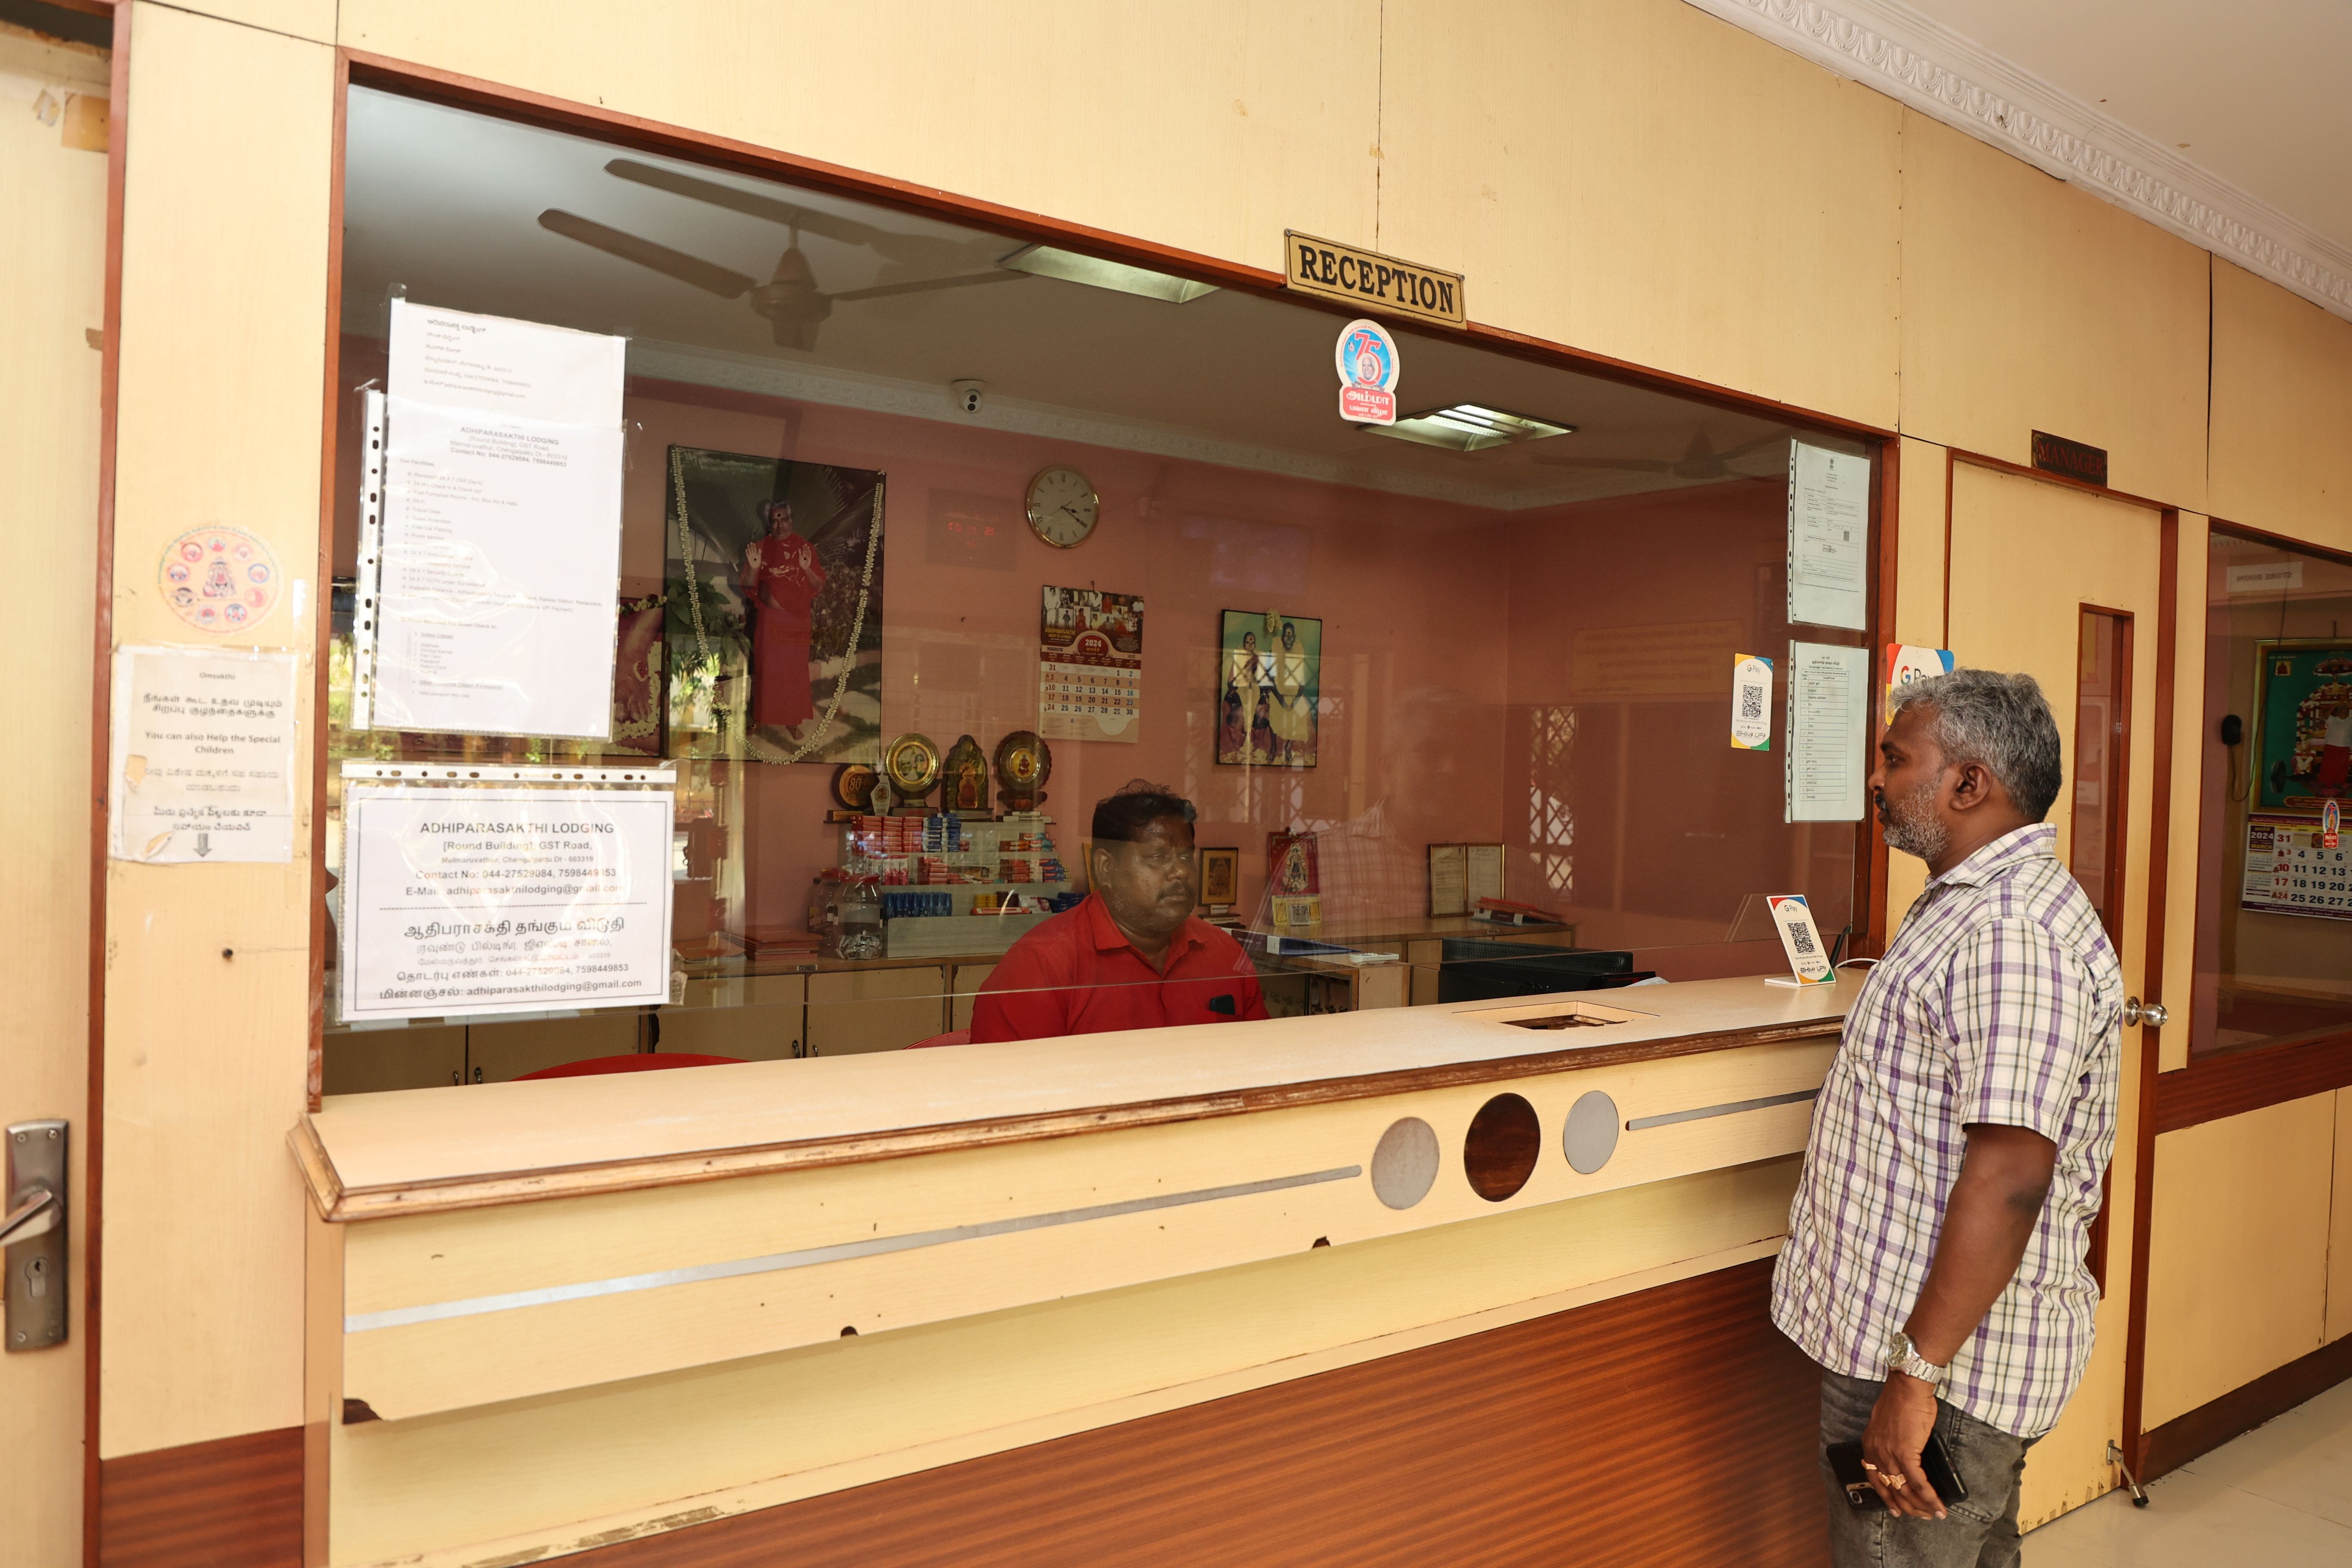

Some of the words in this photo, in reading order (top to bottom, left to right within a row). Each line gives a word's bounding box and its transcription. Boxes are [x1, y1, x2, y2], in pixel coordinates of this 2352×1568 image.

[1298, 245, 1453, 314] RECEPTION
[1354, 332, 1382, 386] 75
[1346, 391, 1390, 405] அம்மா
[461, 426, 525, 441] ADHIPARASAKTHI
[527, 435, 559, 445] LODGING
[450, 447, 475, 455] Contact
[2038, 441, 2105, 478] MANAGER
[1752, 665, 1761, 675] Pay
[1900, 665, 1911, 686] G
[144, 693, 180, 703] நீங்கள்
[145, 731, 163, 739] You
[207, 734, 228, 742] Help
[248, 735, 281, 744] Special
[195, 745, 235, 754] Children
[420, 823, 548, 833] ADHIPARASAKTHI
[552, 823, 614, 833] LODGING
[2251, 831, 2275, 839] 2024
[2277, 834, 2291, 843] 31
[444, 841, 481, 852] [Round
[539, 841, 560, 850] GST
[564, 841, 592, 851] Road,
[2316, 851, 2324, 860] 5
[2335, 853, 2343, 861] 6
[415, 870, 458, 879] Contact
[461, 870, 479, 879] No:
[482, 869, 555, 879] 044-27529084,
[2278, 864, 2290, 872] 10
[2294, 864, 2307, 873] 11
[2312, 866, 2327, 875] 12
[2331, 867, 2346, 876] 13
[2275, 878, 2289, 886] 17
[2292, 879, 2306, 888] 18
[2311, 881, 2326, 889] 19
[2329, 882, 2345, 891] 20
[2291, 894, 2306, 902] 25
[2309, 895, 2324, 904] 26
[2328, 897, 2344, 906] 27
[404, 920, 511, 940] ஆதிபராசக்தி
[515, 919, 572, 936] தங்கும்
[577, 917, 625, 933] விடுதி
[397, 971, 448, 983] தொடர்பு
[452, 968, 503, 979] எண்கள்:
[576, 963, 629, 974] 7598449853
[380, 986, 463, 1000] மின்னஞ்சல்:
[467, 979, 642, 996] adhiparasakthilodging@gmail.com
